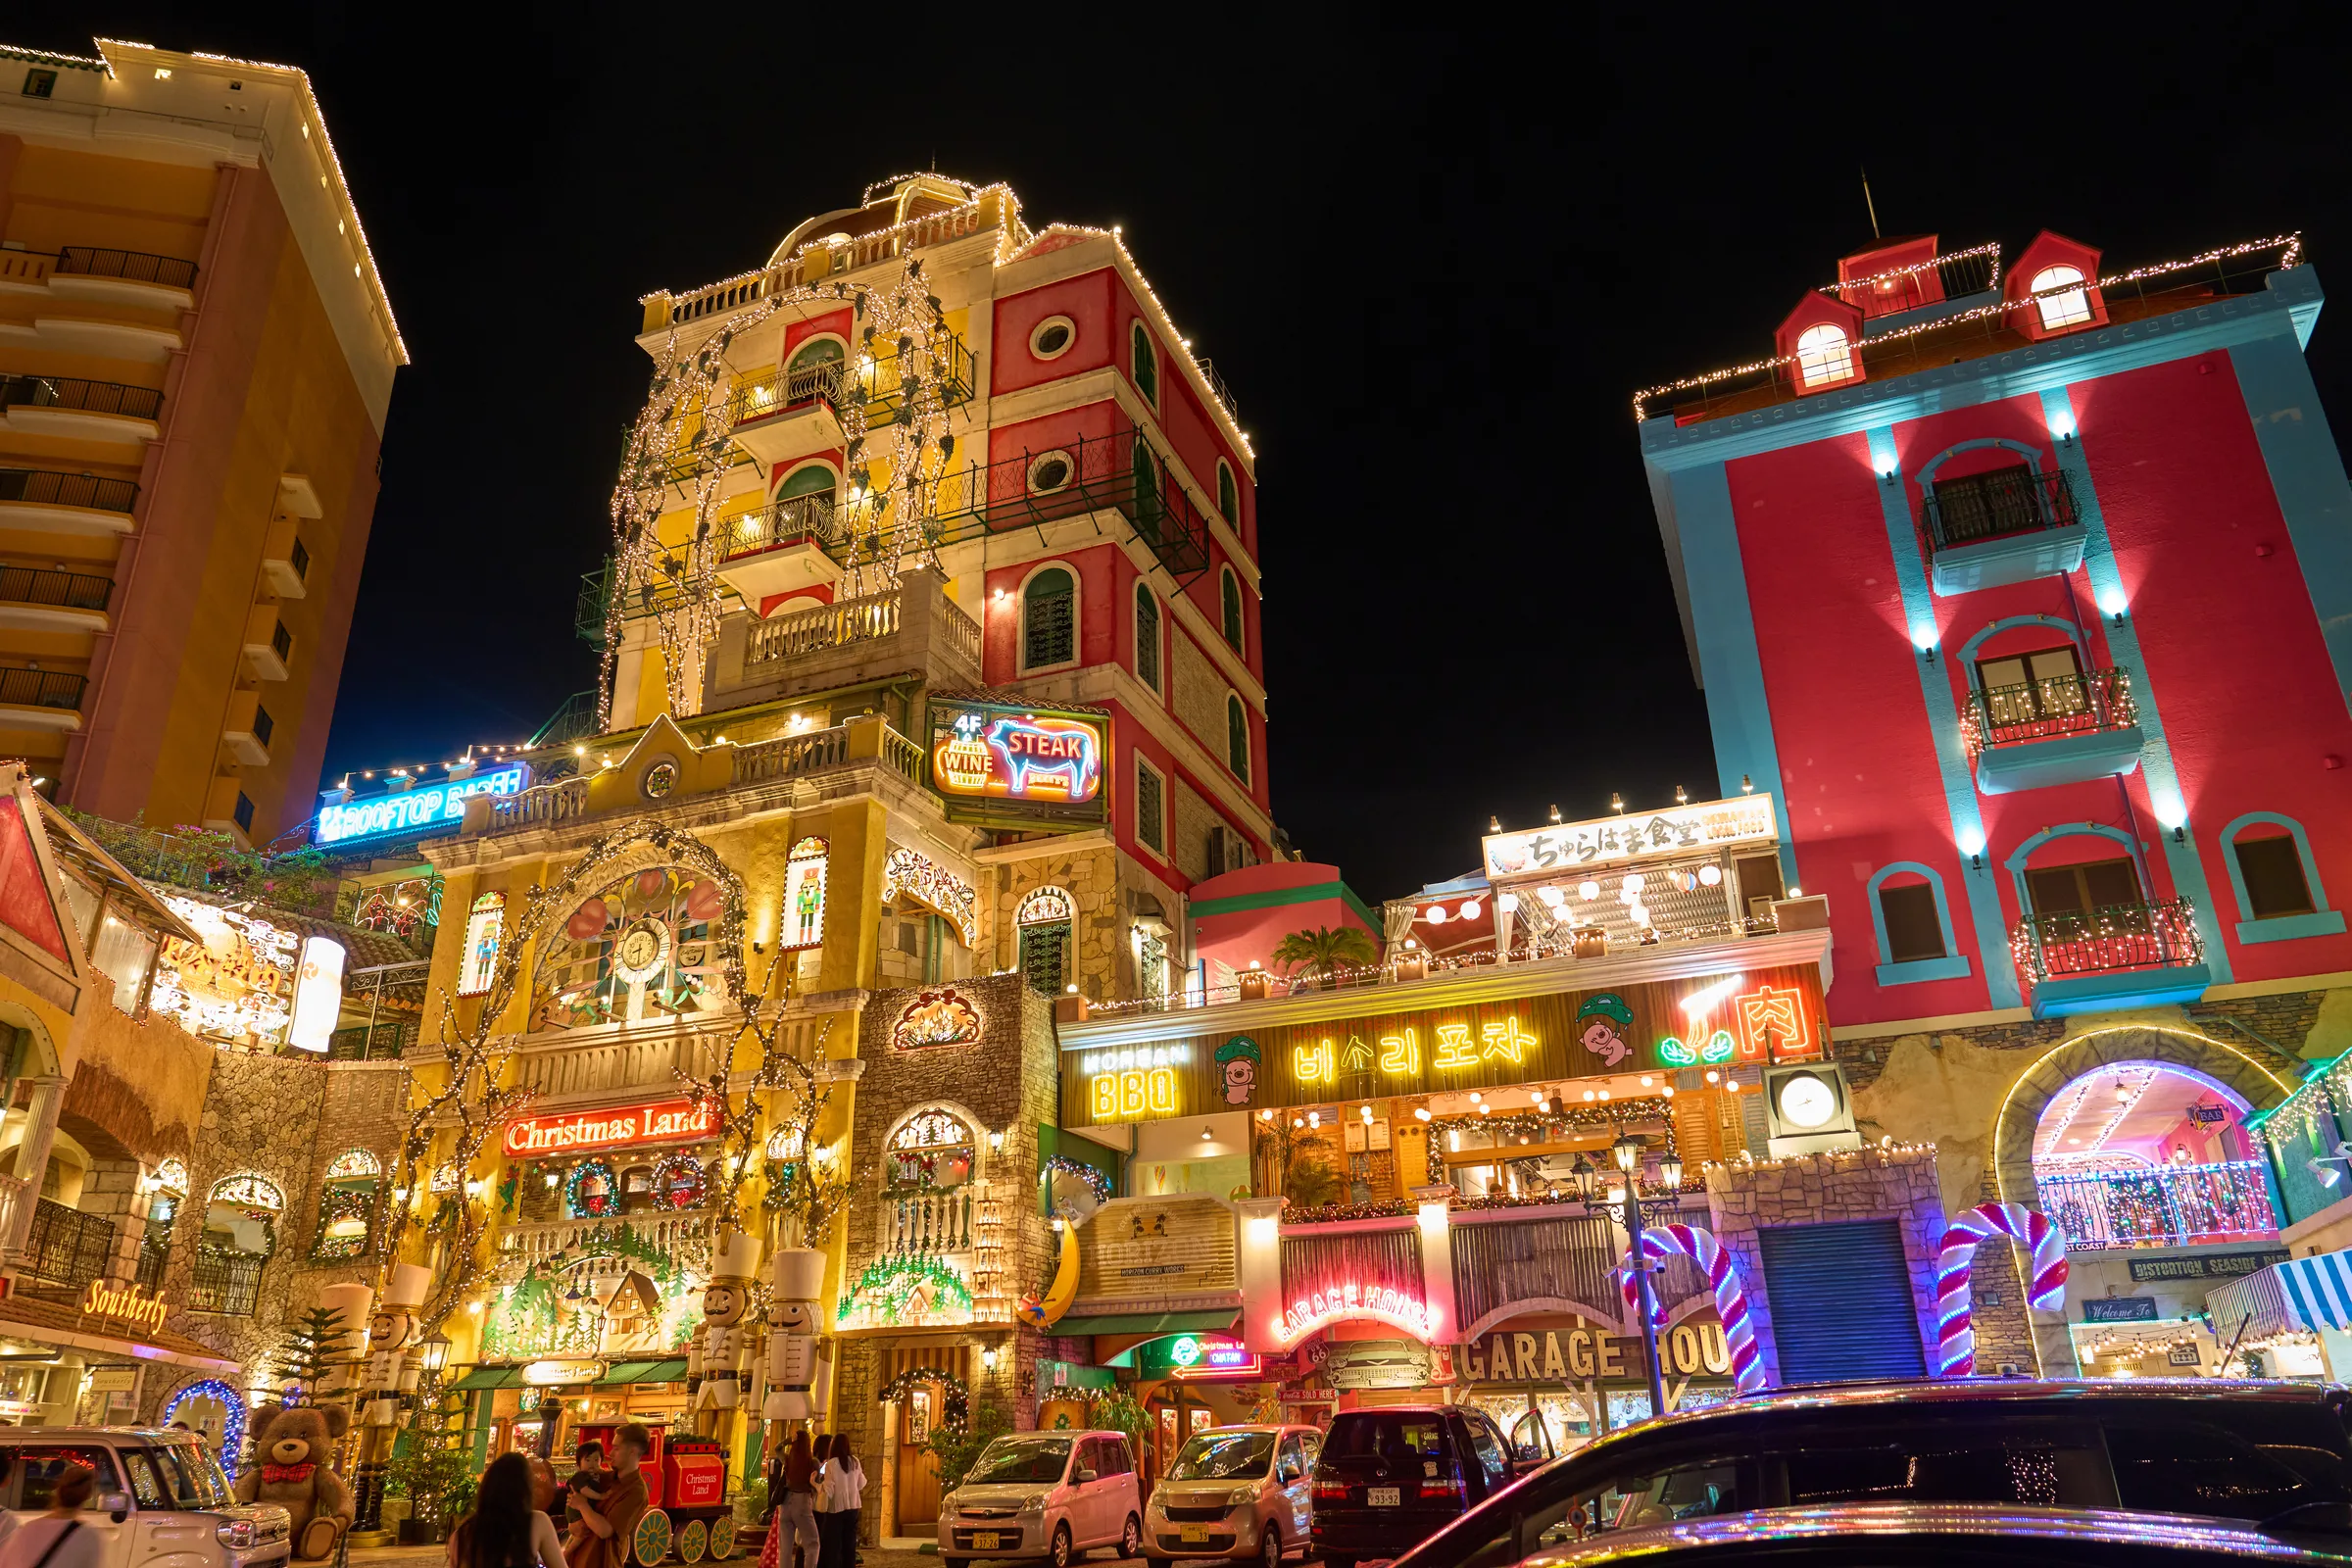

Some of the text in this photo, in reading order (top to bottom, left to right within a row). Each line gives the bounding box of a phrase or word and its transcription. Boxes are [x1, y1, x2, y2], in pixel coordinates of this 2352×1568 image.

[955, 713, 983, 733] 4F
[1008, 731, 1082, 759] STEAK
[944, 752, 993, 772] WINE
[343, 791, 442, 837] ROOFTOP
[1706, 819, 1765, 840] LOCAL FOOD
[1528, 815, 1700, 868] ちゅらはま食堂
[1293, 1019, 1358, 1041] KOREAN
[1733, 985, 1810, 1054] 肉
[1434, 1015, 1538, 1069] 포차
[1084, 1045, 1189, 1073] KOREAN
[1092, 1069, 1175, 1117] BBQ
[508, 1101, 709, 1151] Christmas Land
[2199, 1111, 2224, 1120] BAR
[2077, 1242, 2105, 1250] COAST
[1121, 1265, 1184, 1277] HORIZON CURRY WORKS
[2135, 1260, 2203, 1277] DISTORTION
[2210, 1256, 2257, 1273] SEASIDE
[84, 1279, 169, 1336] Southerly
[1272, 1286, 1442, 1342] GARAGE HOUSE
[2092, 1303, 2150, 1319] Welcome To
[1199, 1341, 1245, 1351] Christmas La
[1312, 1348, 1327, 1362] 66
[1461, 1325, 1730, 1381] GARAGE HOU
[1302, 1390, 1316, 1399] SOLD
[1319, 1390, 1333, 1398] HERE
[686, 1473, 716, 1495] Christmas Land
[1375, 1494, 1398, 1504] 93-92
[979, 1539, 998, 1548] 37-26
